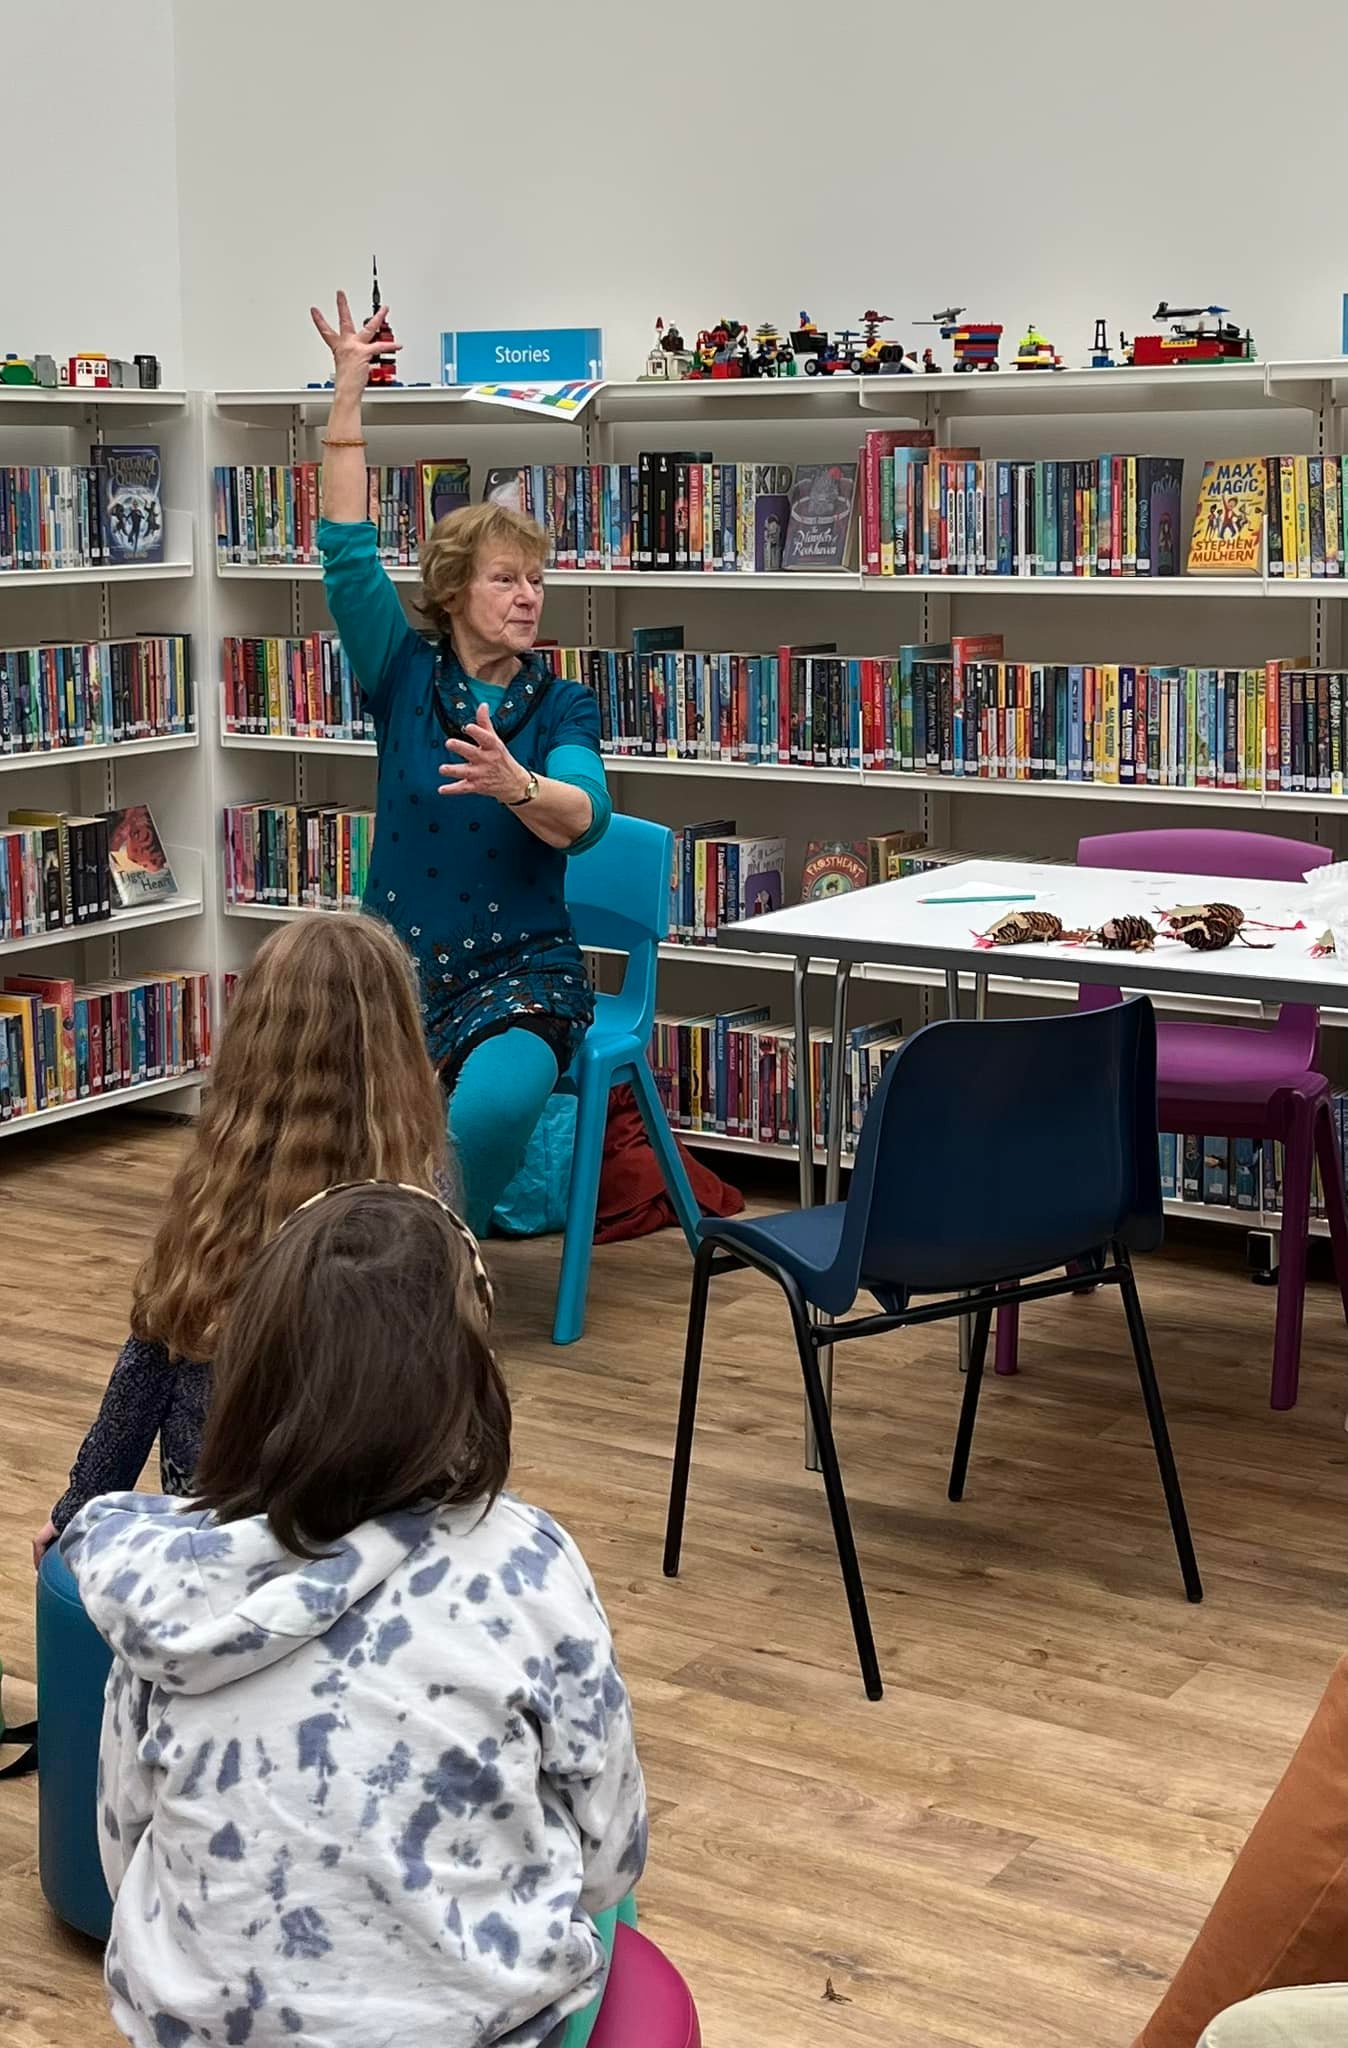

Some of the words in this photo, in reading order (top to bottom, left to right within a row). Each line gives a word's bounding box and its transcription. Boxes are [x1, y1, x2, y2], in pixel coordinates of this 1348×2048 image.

[495, 345, 550, 364] Stories
[755, 465, 793, 494] KID
[1217, 463, 1256, 481] MAX
[1208, 478, 1258, 496] MAGIC
[1195, 538, 1254, 551] STEPHEN
[1192, 551, 1255, 562] MULHERN
[1124, 709, 1133, 726] MAX
[1124, 727, 1133, 760] EINSTEIN
[1281, 731, 1291, 764] GOLD
[806, 855, 865, 878] FROSTHEART
[118, 870, 146, 884] Tiger
[142, 875, 171, 891] Heart
